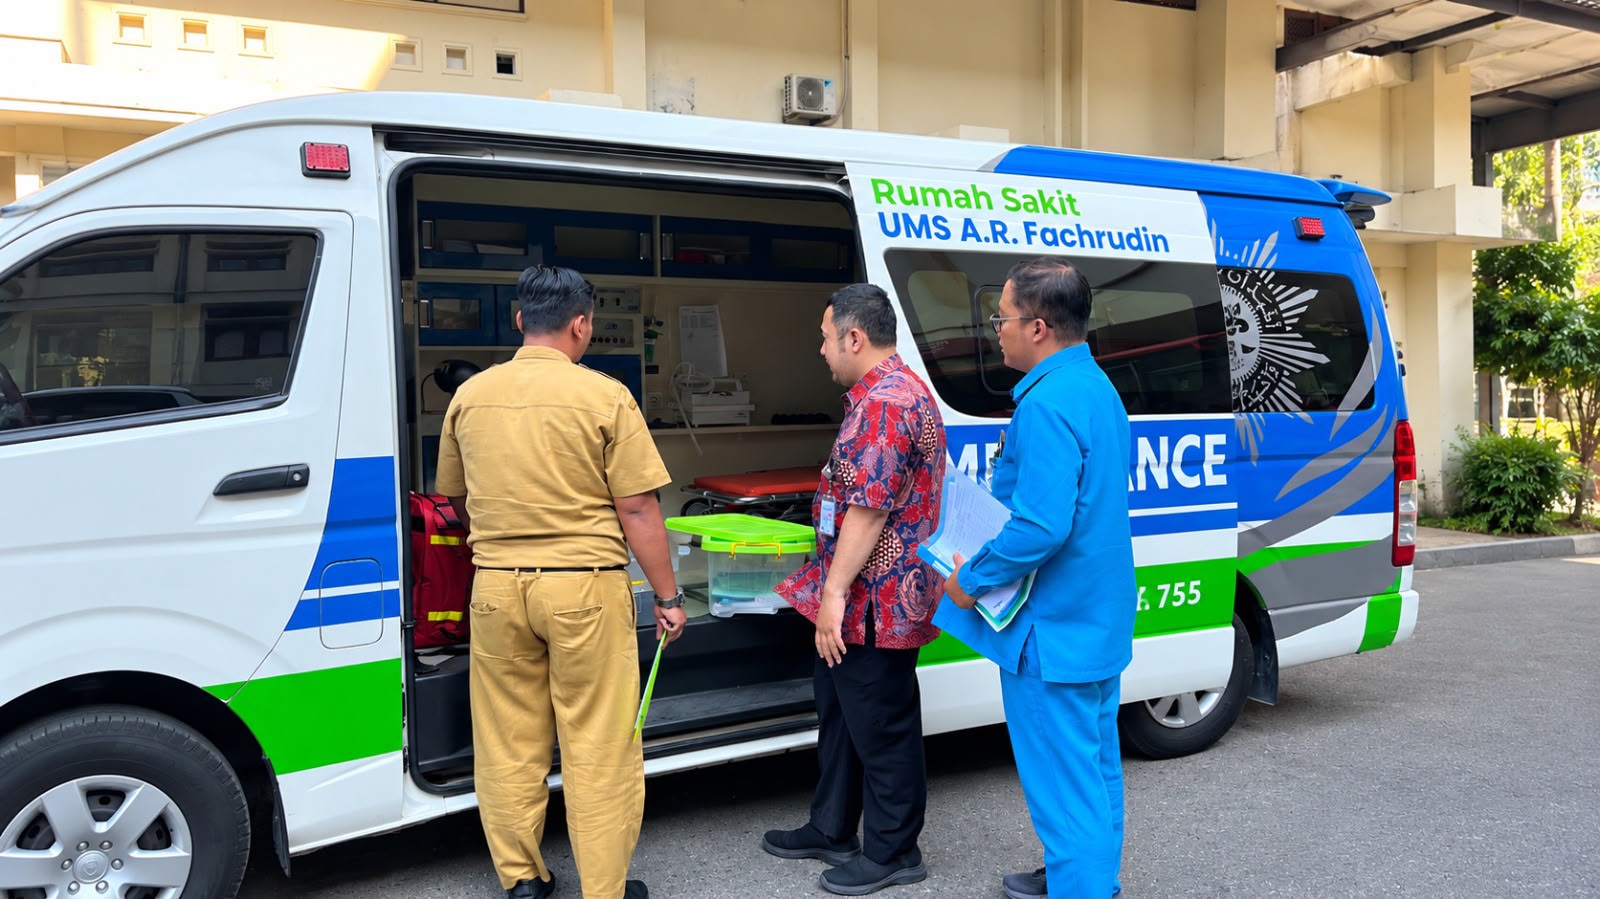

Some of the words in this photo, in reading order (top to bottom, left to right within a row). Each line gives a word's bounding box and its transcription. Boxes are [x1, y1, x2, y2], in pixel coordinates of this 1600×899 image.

[871, 178, 993, 210] Rumah
[1001, 187, 1081, 216] Sakit
[878, 211, 951, 240] UMS
[960, 217, 1018, 244] A.R.
[1023, 221, 1170, 253] Fachrudin
[1157, 580, 1201, 608] 755
